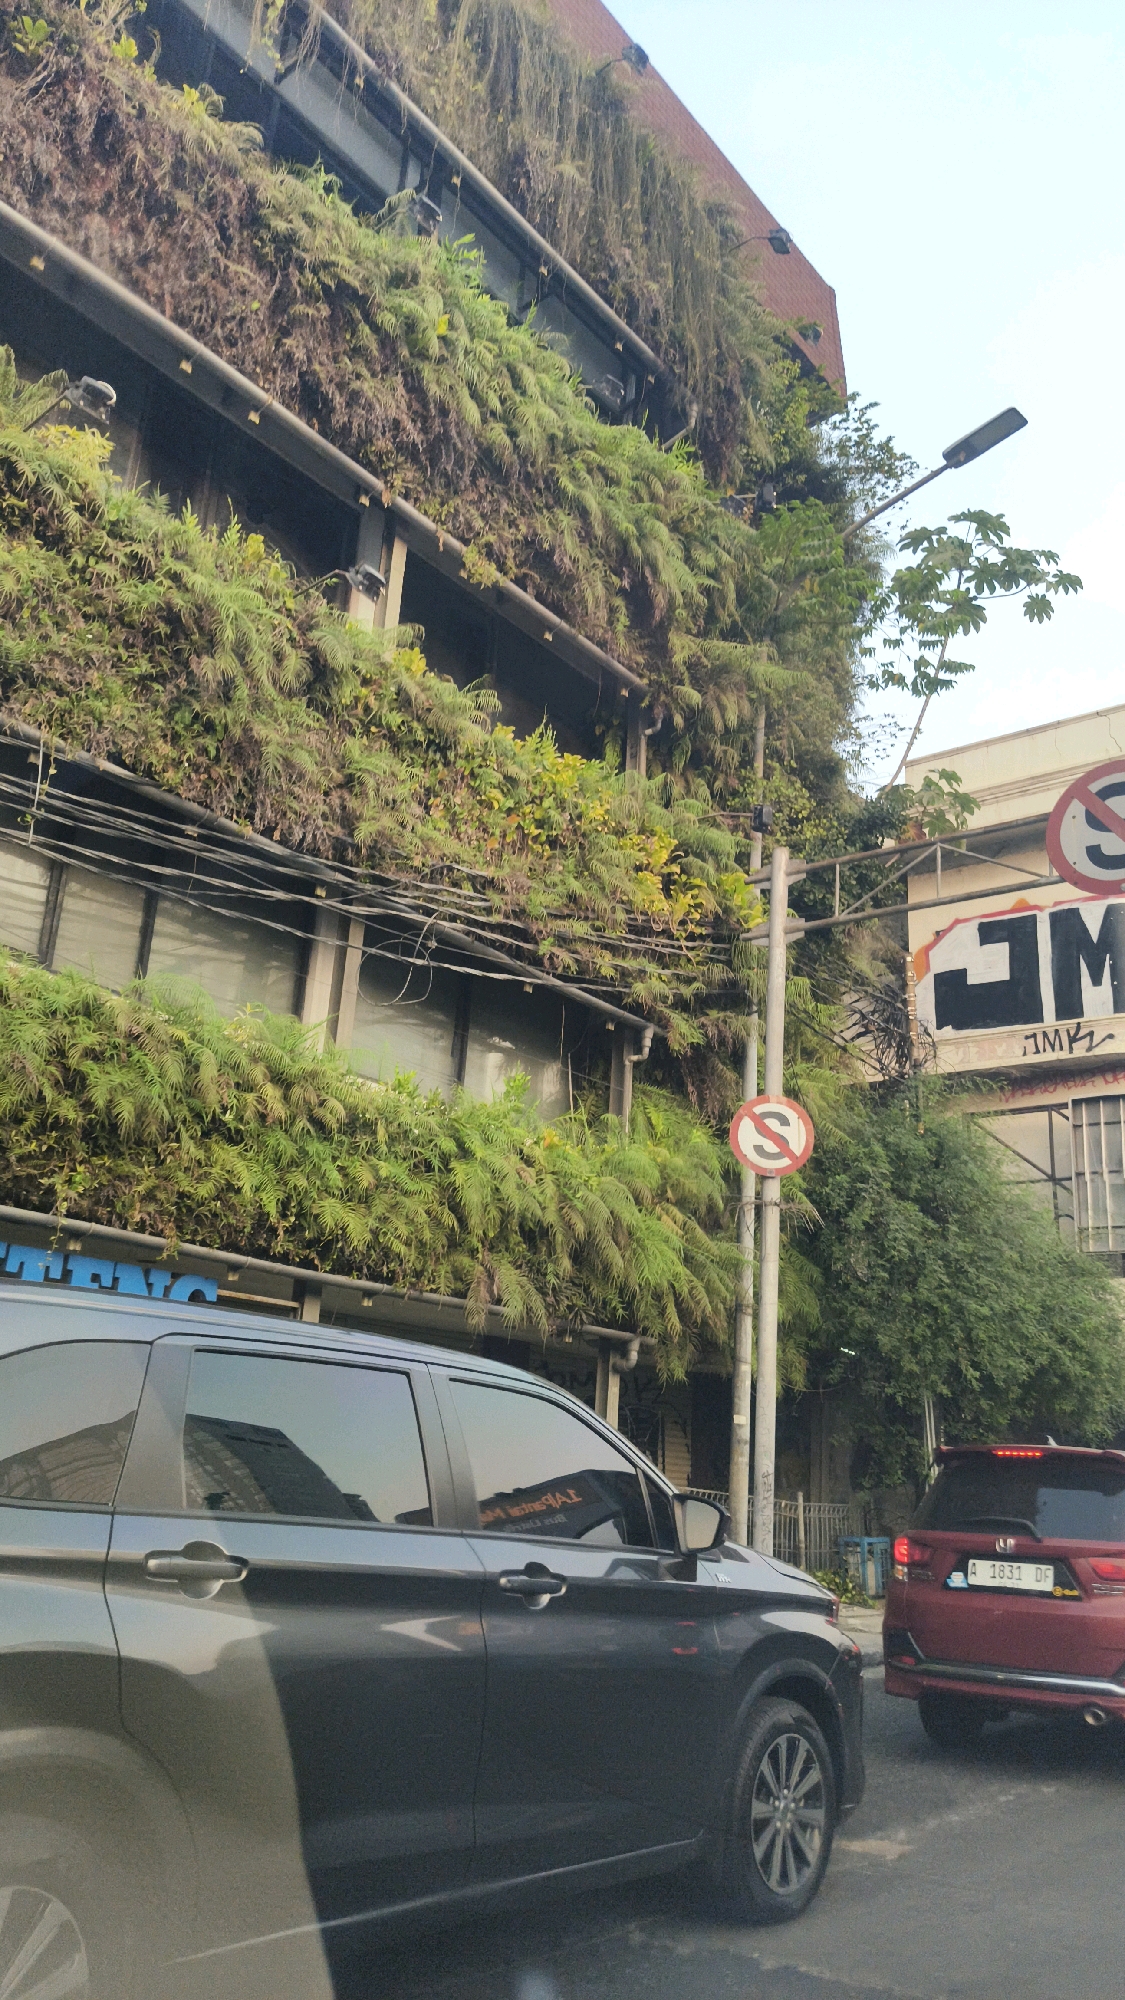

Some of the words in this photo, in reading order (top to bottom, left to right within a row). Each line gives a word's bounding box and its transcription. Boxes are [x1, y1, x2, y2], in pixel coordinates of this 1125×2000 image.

[753, 1111, 790, 1160] S
[970, 1562, 977, 1578] A
[989, 1563, 1023, 1582] 1831
